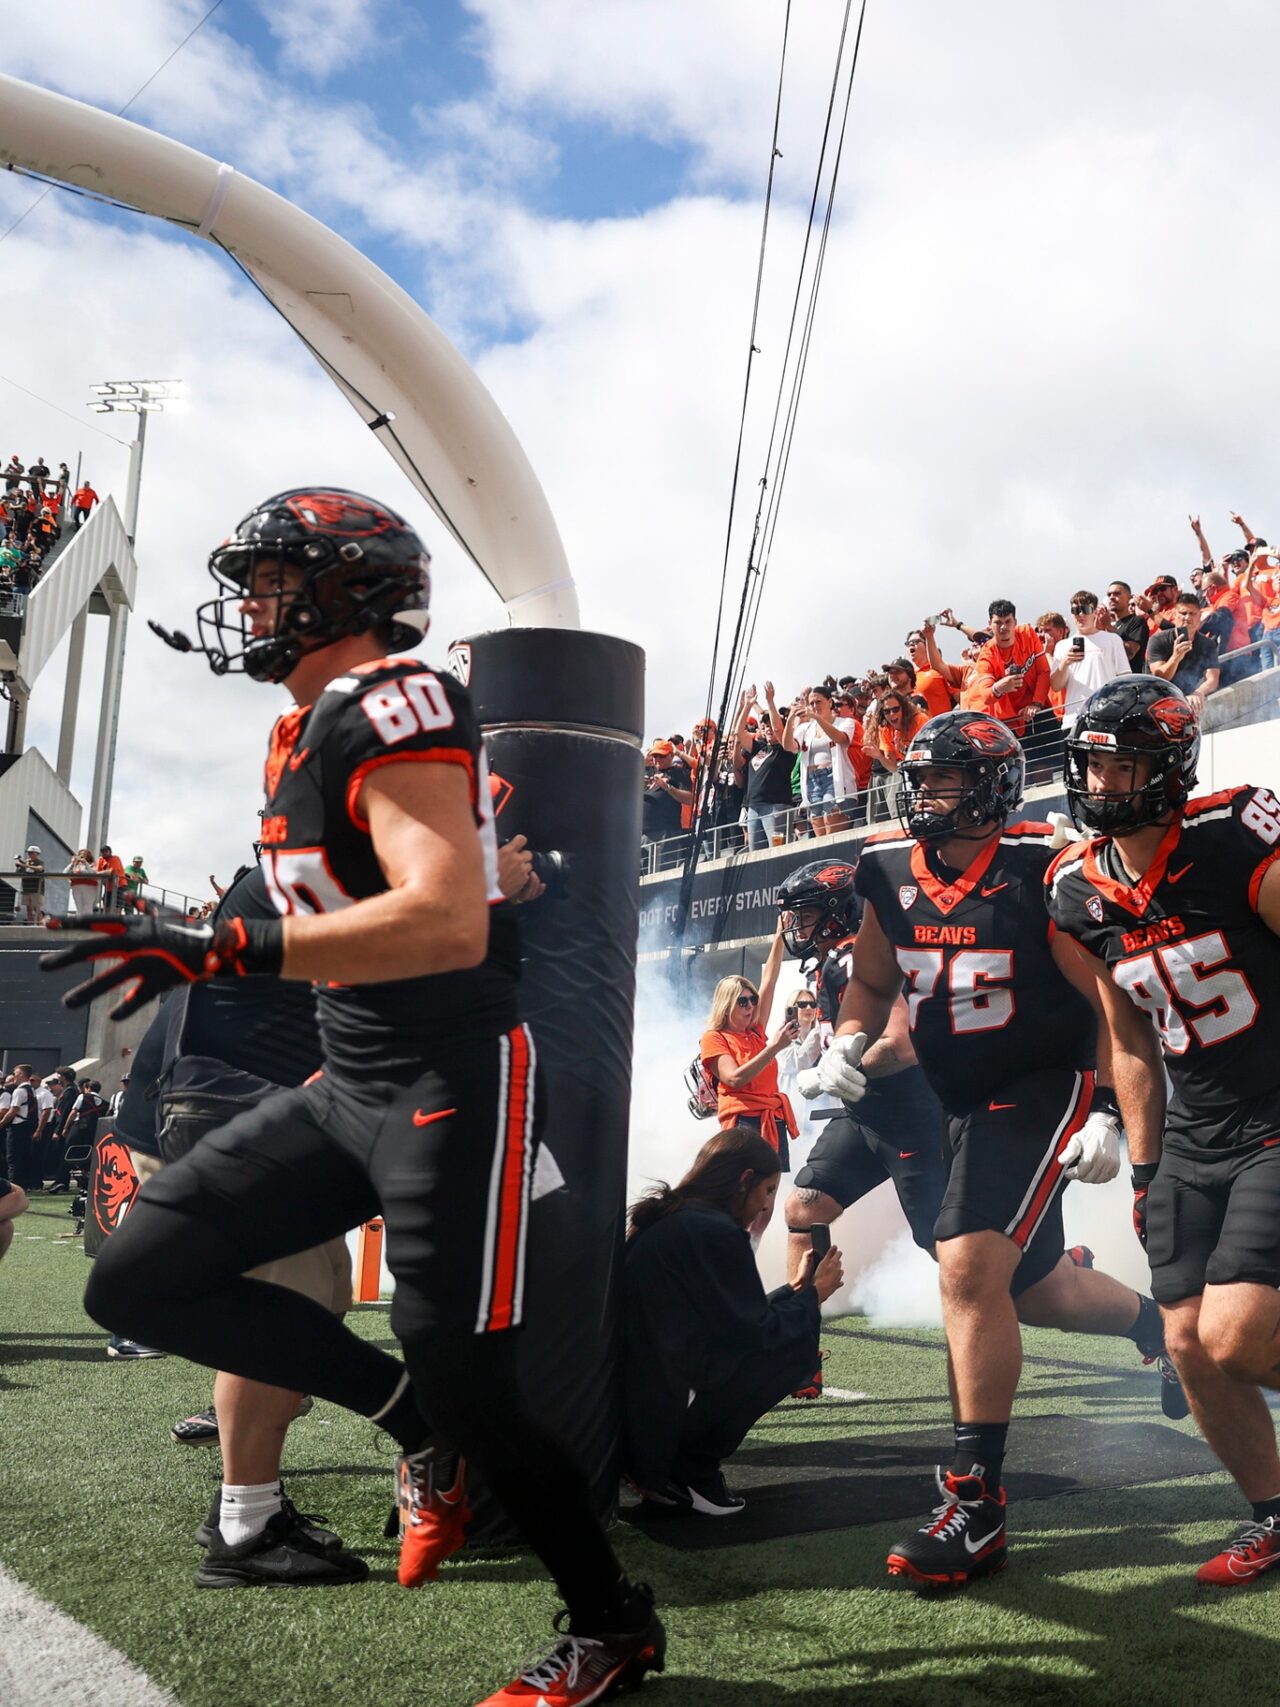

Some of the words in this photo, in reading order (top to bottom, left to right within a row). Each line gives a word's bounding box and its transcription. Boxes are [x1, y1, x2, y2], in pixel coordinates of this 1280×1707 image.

[360, 672, 454, 746] 80
[664, 904, 680, 924] FO
[913, 925, 977, 945] BEAVS
[1120, 915, 1186, 953] BEAVS
[894, 945, 1017, 1035] 76
[1111, 929, 1261, 1055] 85
